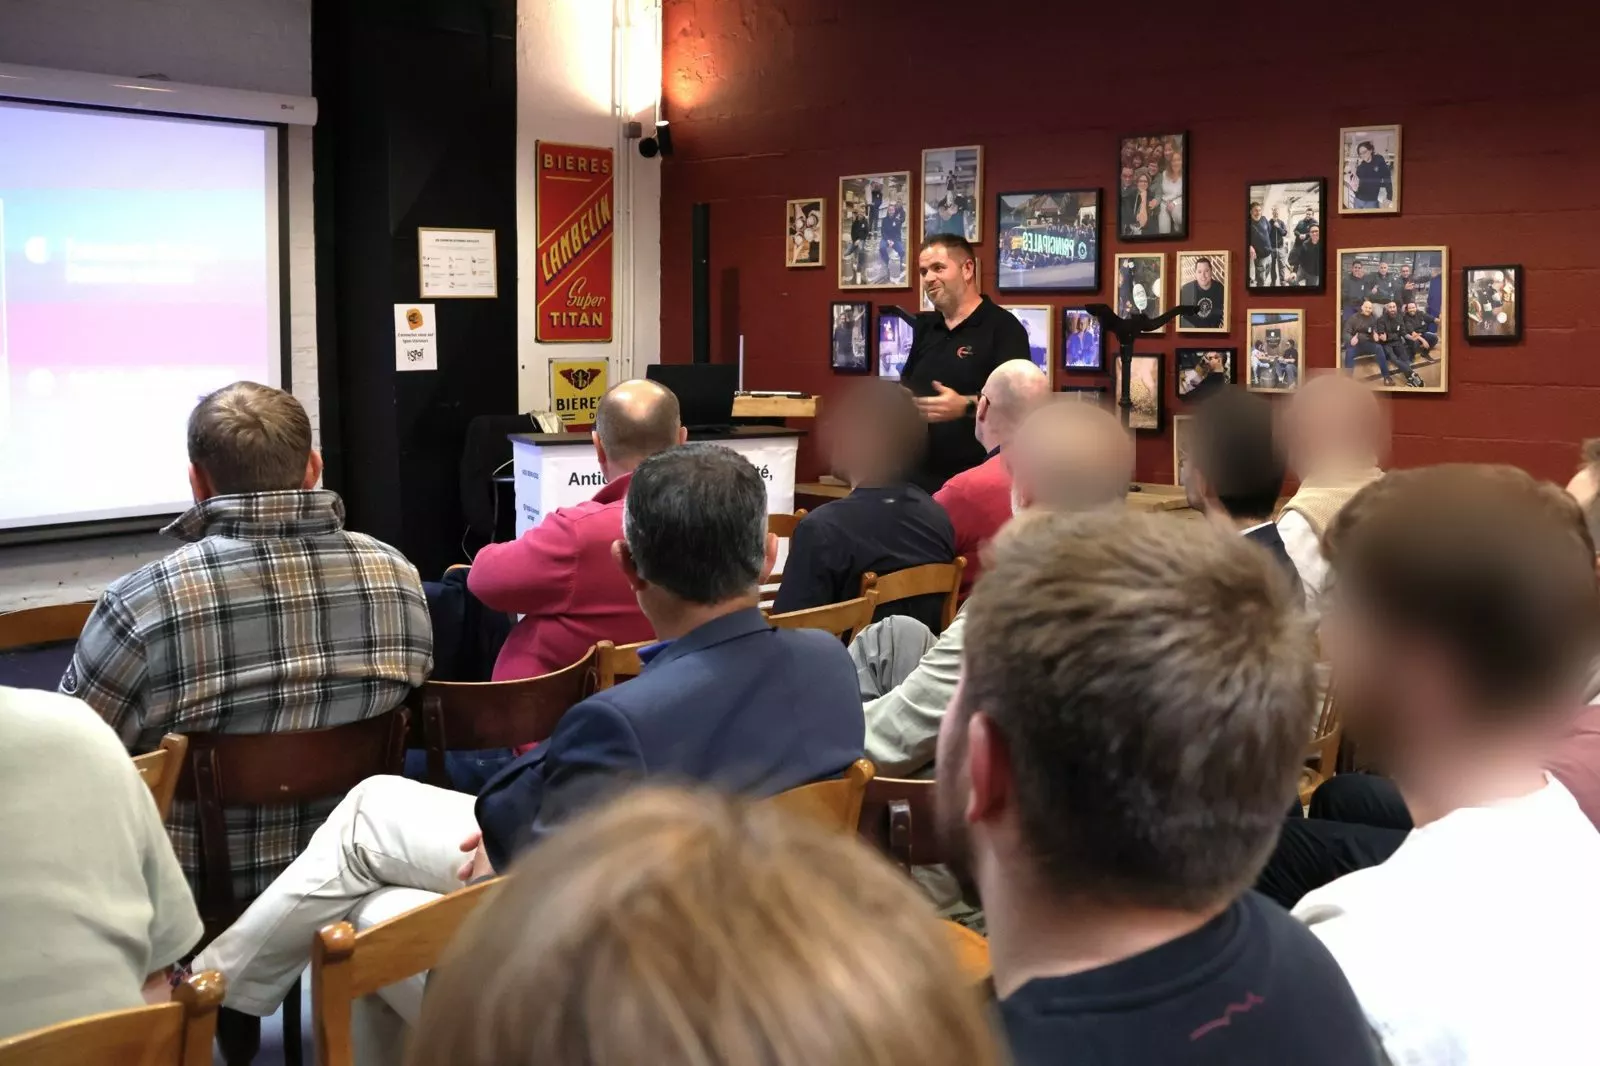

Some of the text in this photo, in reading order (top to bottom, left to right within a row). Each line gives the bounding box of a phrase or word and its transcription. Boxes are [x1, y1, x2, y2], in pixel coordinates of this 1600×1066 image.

[541, 193, 611, 281] LAMBELIN
[566, 276, 606, 310] Super
[550, 311, 603, 327] TITAN
